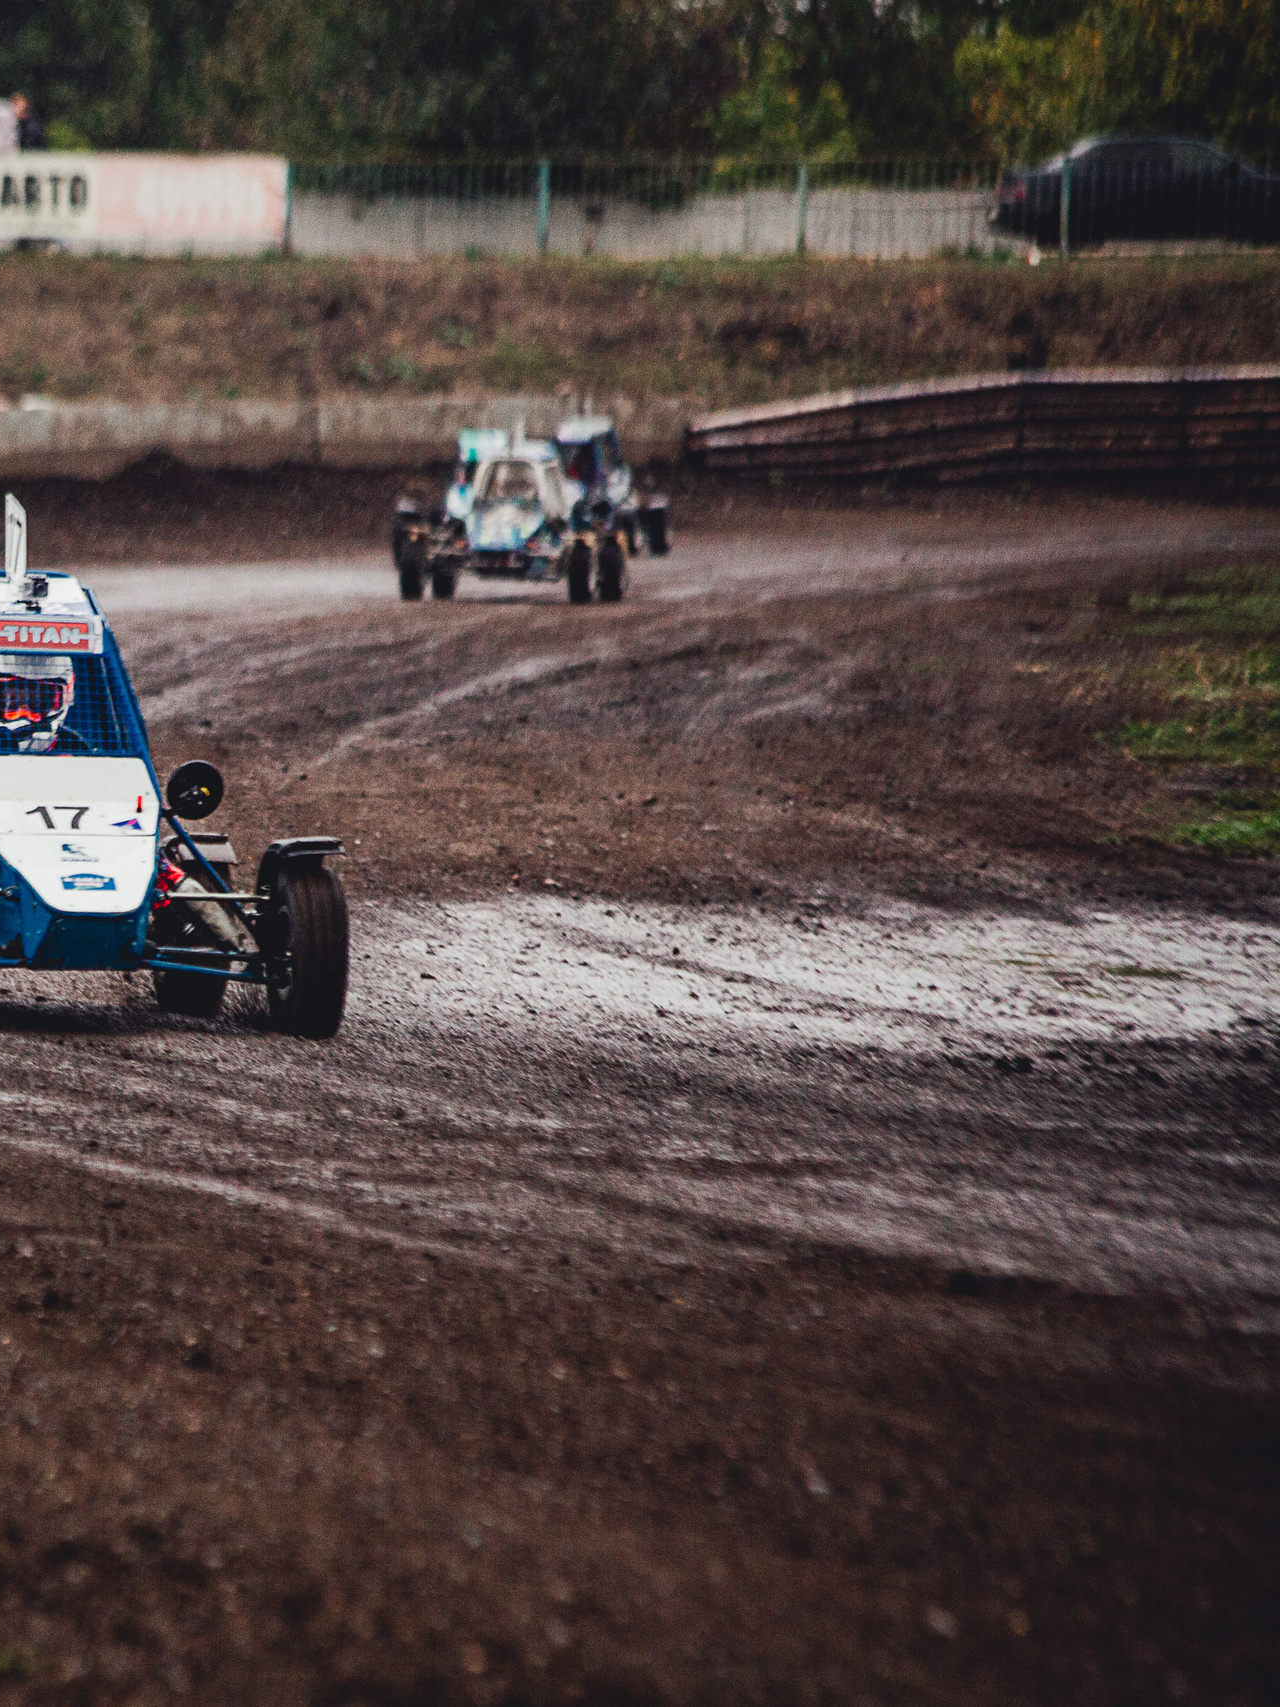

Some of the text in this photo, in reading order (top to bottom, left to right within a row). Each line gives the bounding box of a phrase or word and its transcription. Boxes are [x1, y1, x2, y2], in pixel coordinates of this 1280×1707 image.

[0, 172, 89, 210] АВТО
[2, 624, 81, 644] TITAN
[25, 806, 89, 829] 17
